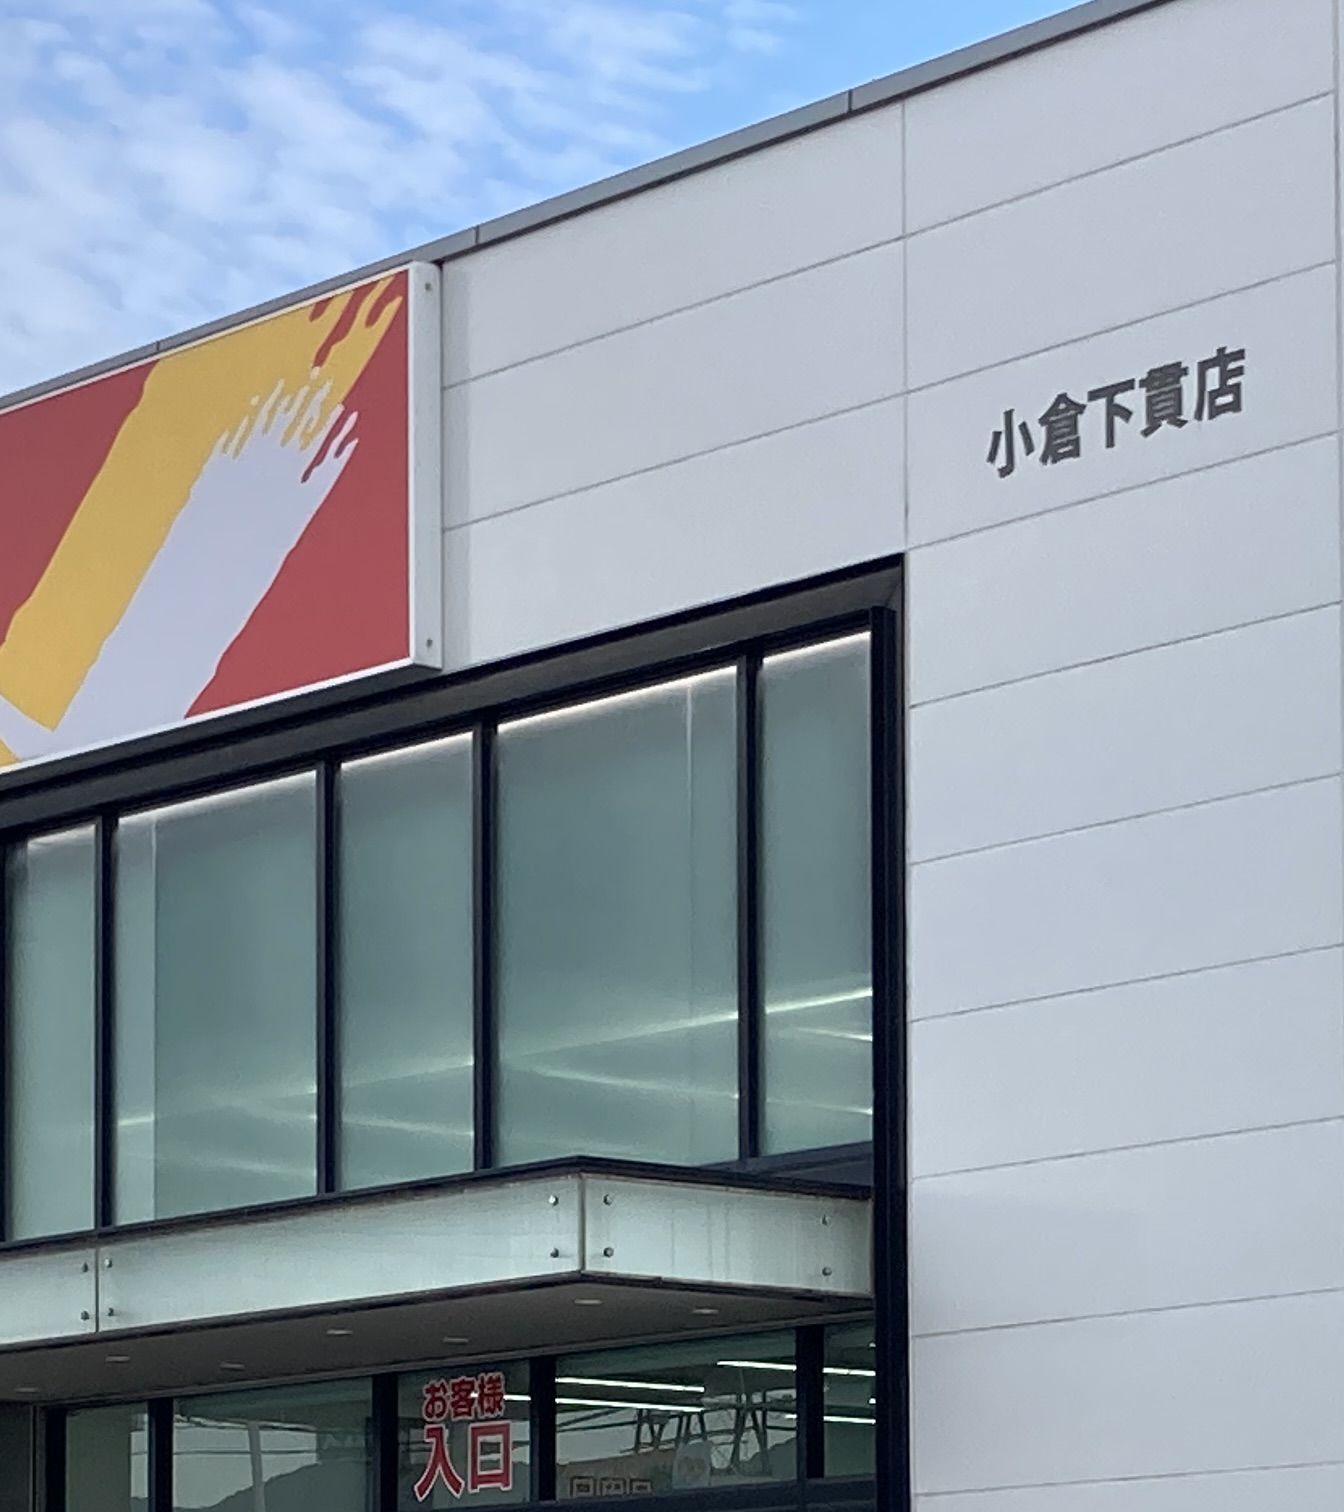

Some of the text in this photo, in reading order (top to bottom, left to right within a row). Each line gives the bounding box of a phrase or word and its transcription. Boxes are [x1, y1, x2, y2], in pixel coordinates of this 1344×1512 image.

[987, 346, 1245, 478] 小倉下貫店
[423, 1371, 505, 1422] お客様
[414, 1421, 512, 1502] 入口
